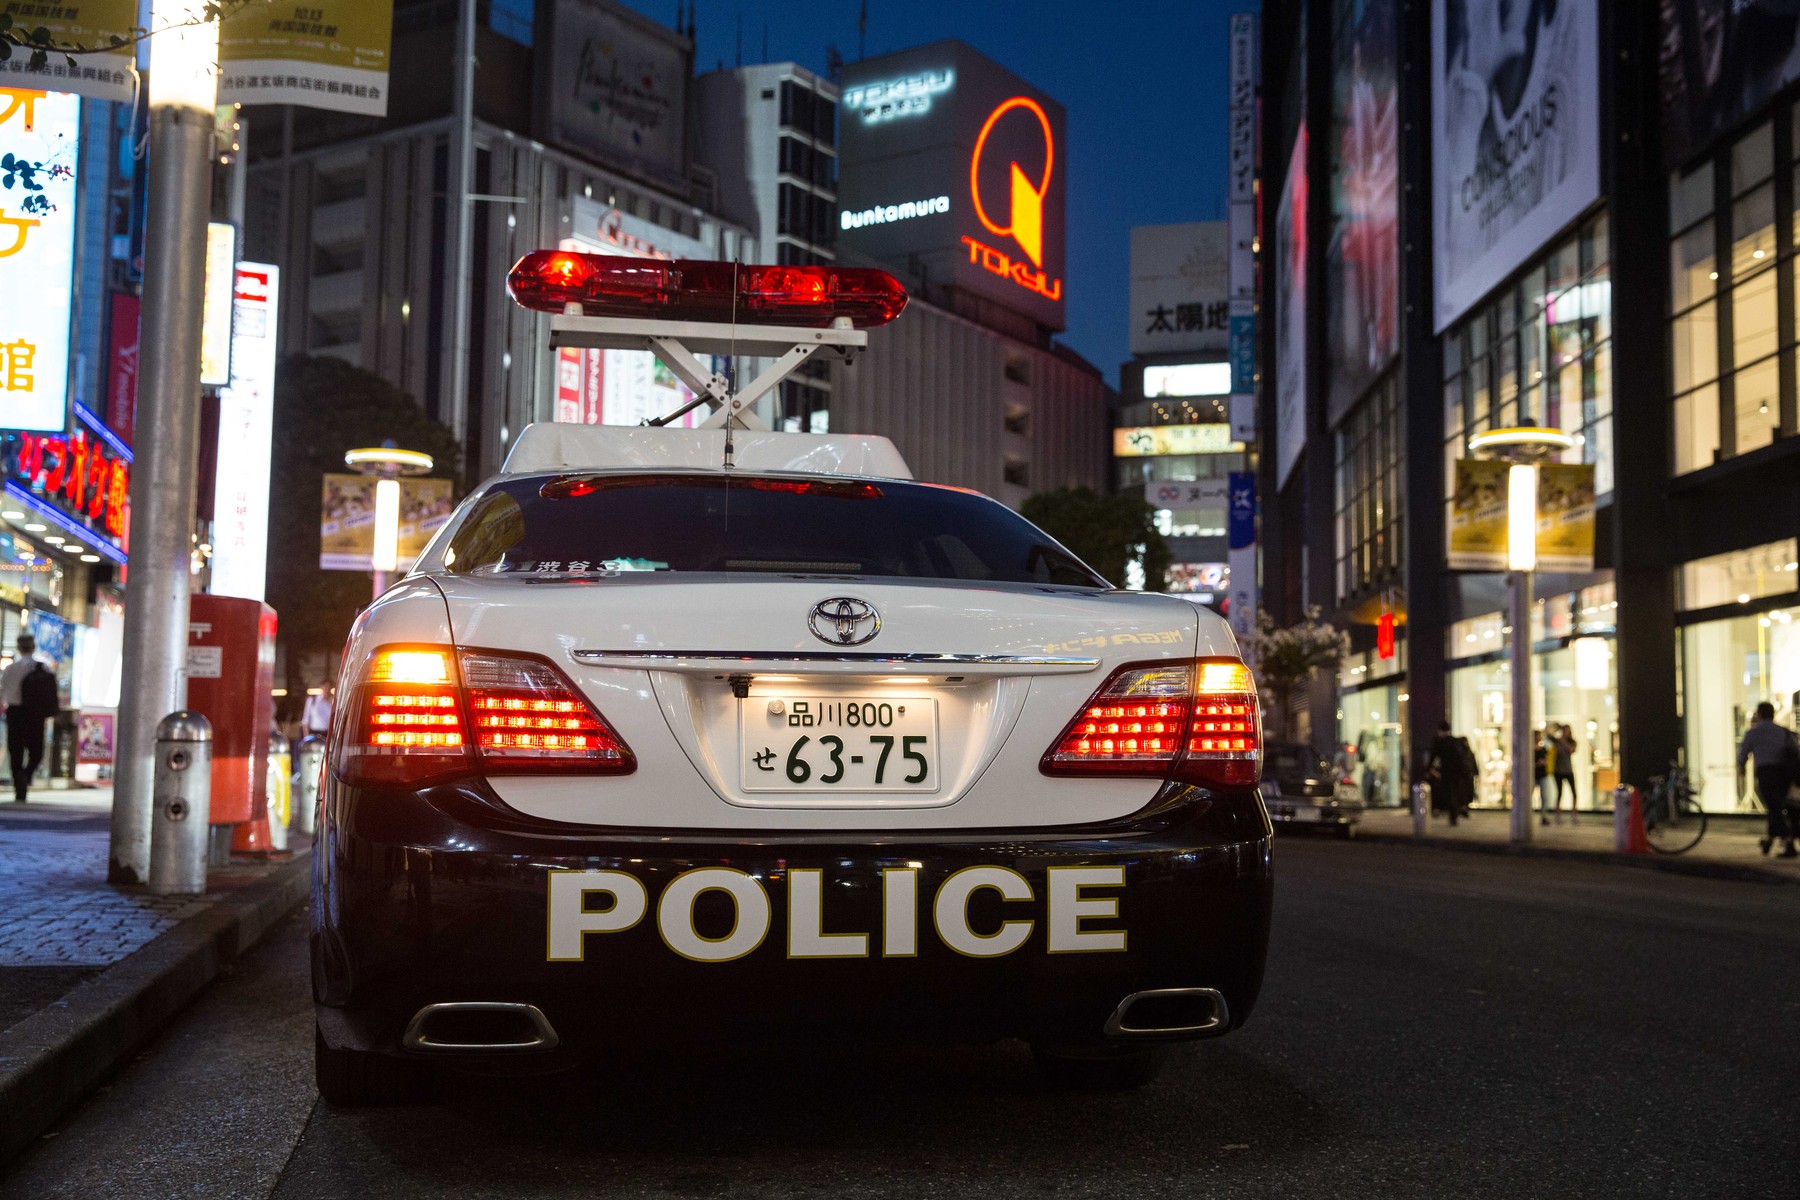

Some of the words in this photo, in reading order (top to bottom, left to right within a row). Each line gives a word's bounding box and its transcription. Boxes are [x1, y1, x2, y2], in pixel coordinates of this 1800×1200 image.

[841, 195, 950, 230] Bunkamura
[961, 235, 1062, 301] TOKYU
[788, 701, 842, 727] 品川
[846, 702, 893, 727] 800
[752, 746, 778, 772] せ
[785, 734, 929, 784] 63-75
[546, 864, 1129, 964] POLICE
